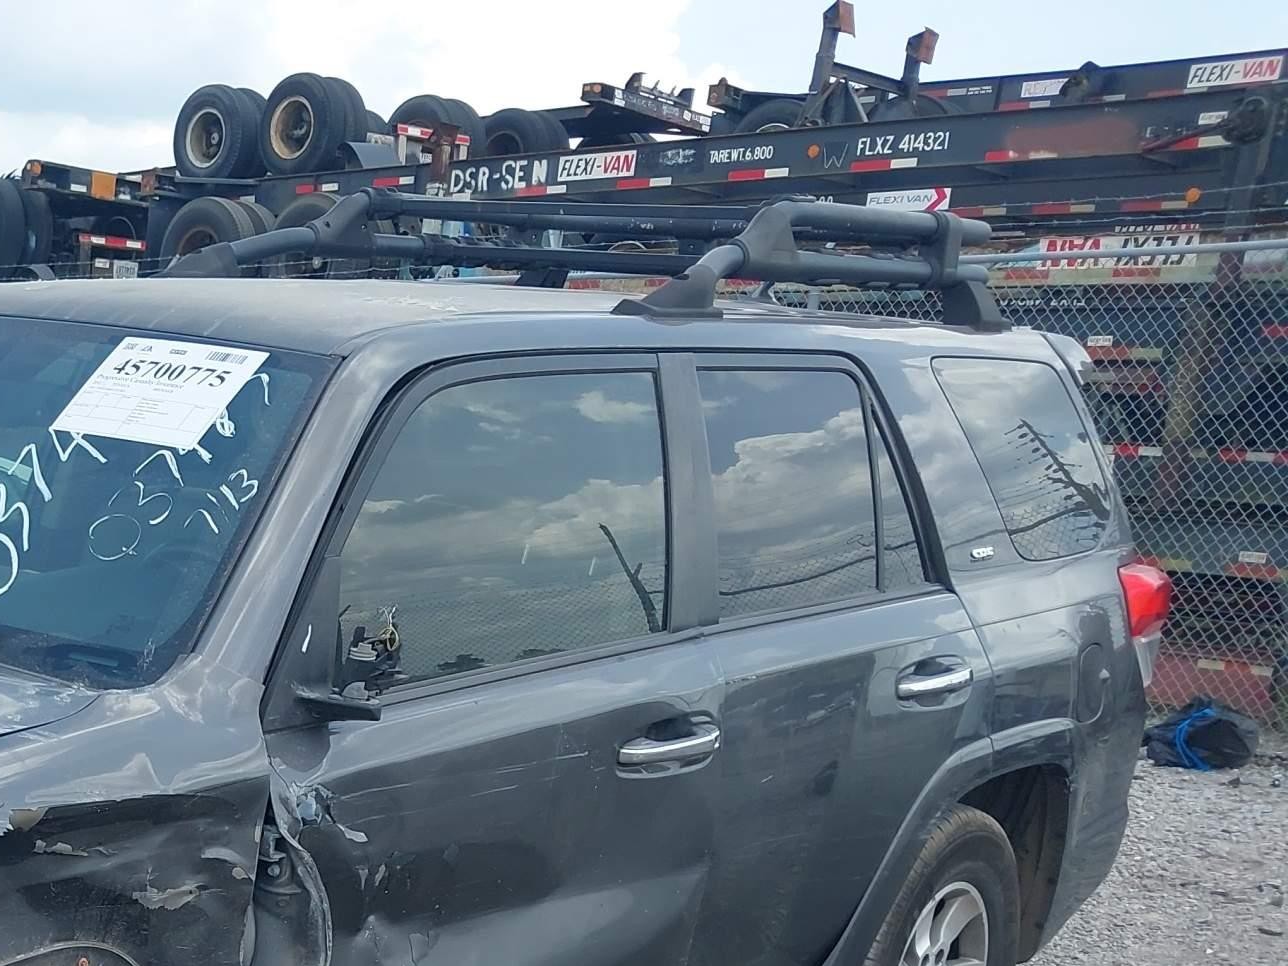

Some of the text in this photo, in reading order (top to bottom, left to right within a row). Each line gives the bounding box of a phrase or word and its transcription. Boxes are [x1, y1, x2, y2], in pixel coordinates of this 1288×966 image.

[1188, 58, 1281, 84] FLEXI-VAN
[856, 131, 951, 157] FLXZ 414321
[558, 153, 635, 179] FLEXI-VAN
[113, 358, 233, 388] 45700775
